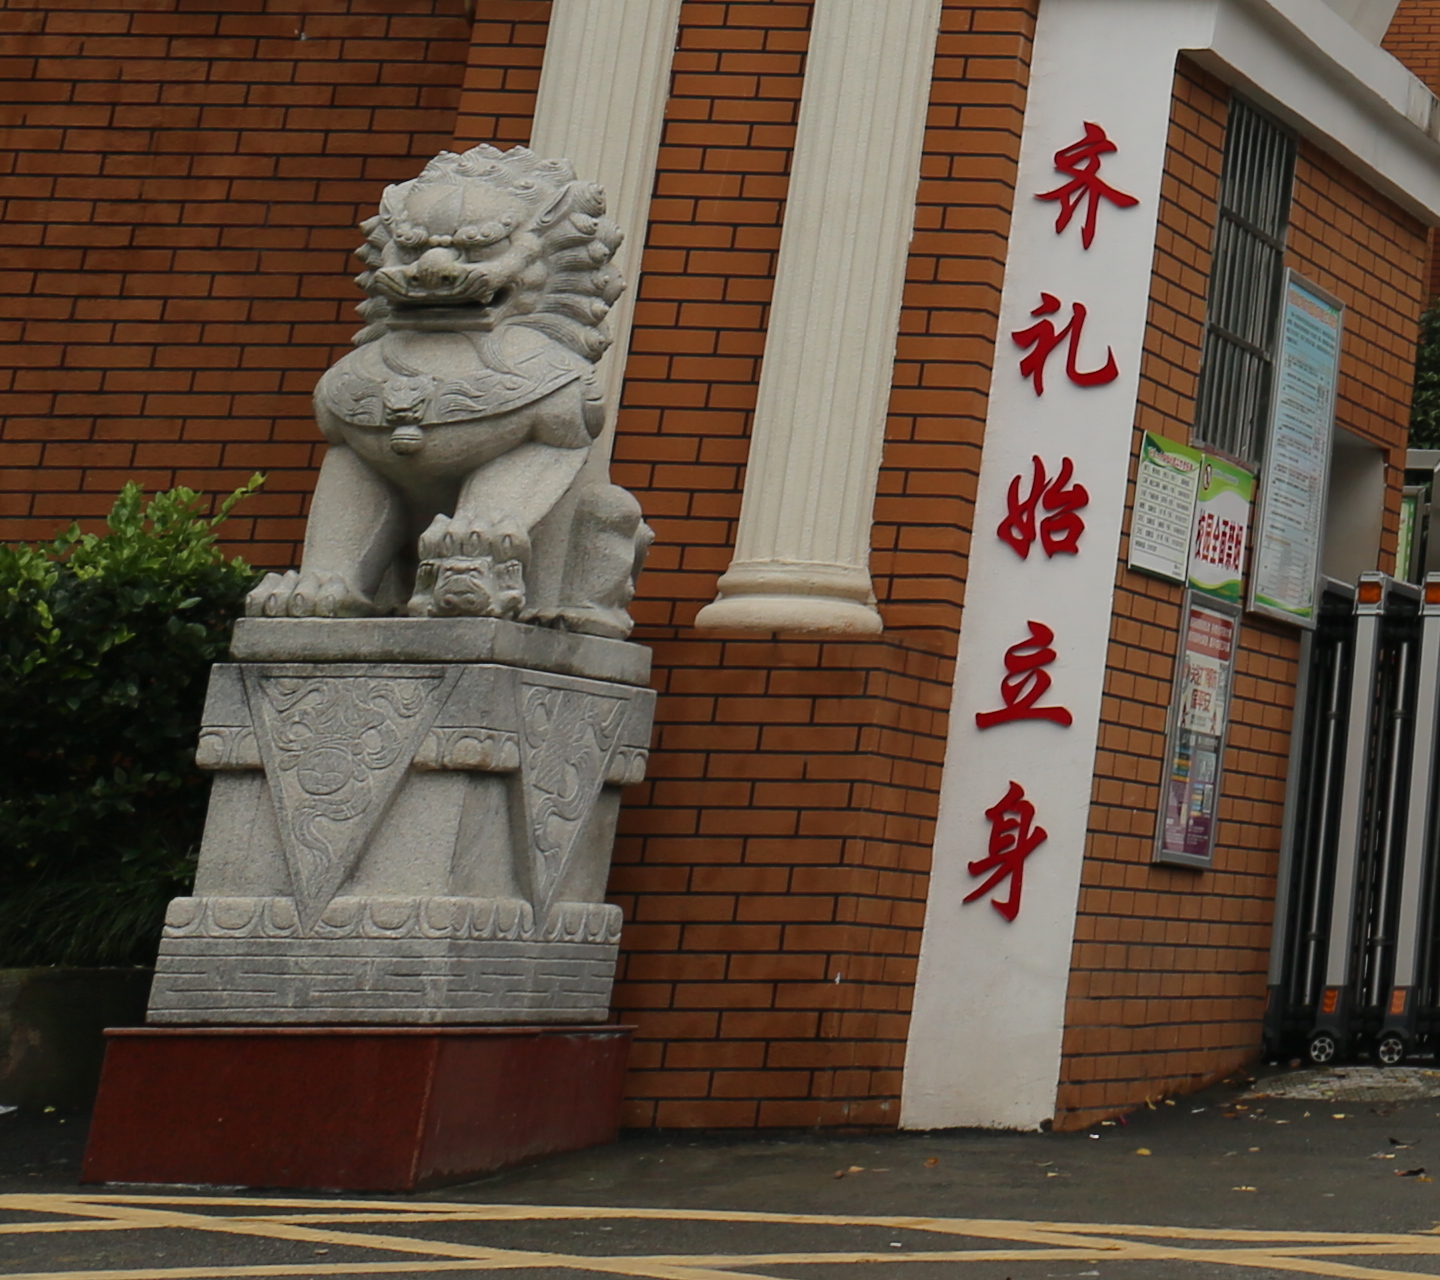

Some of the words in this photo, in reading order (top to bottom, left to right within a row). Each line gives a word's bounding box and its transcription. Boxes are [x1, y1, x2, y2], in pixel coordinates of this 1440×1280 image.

[964, 122, 1138, 921] 齐礼始立身
